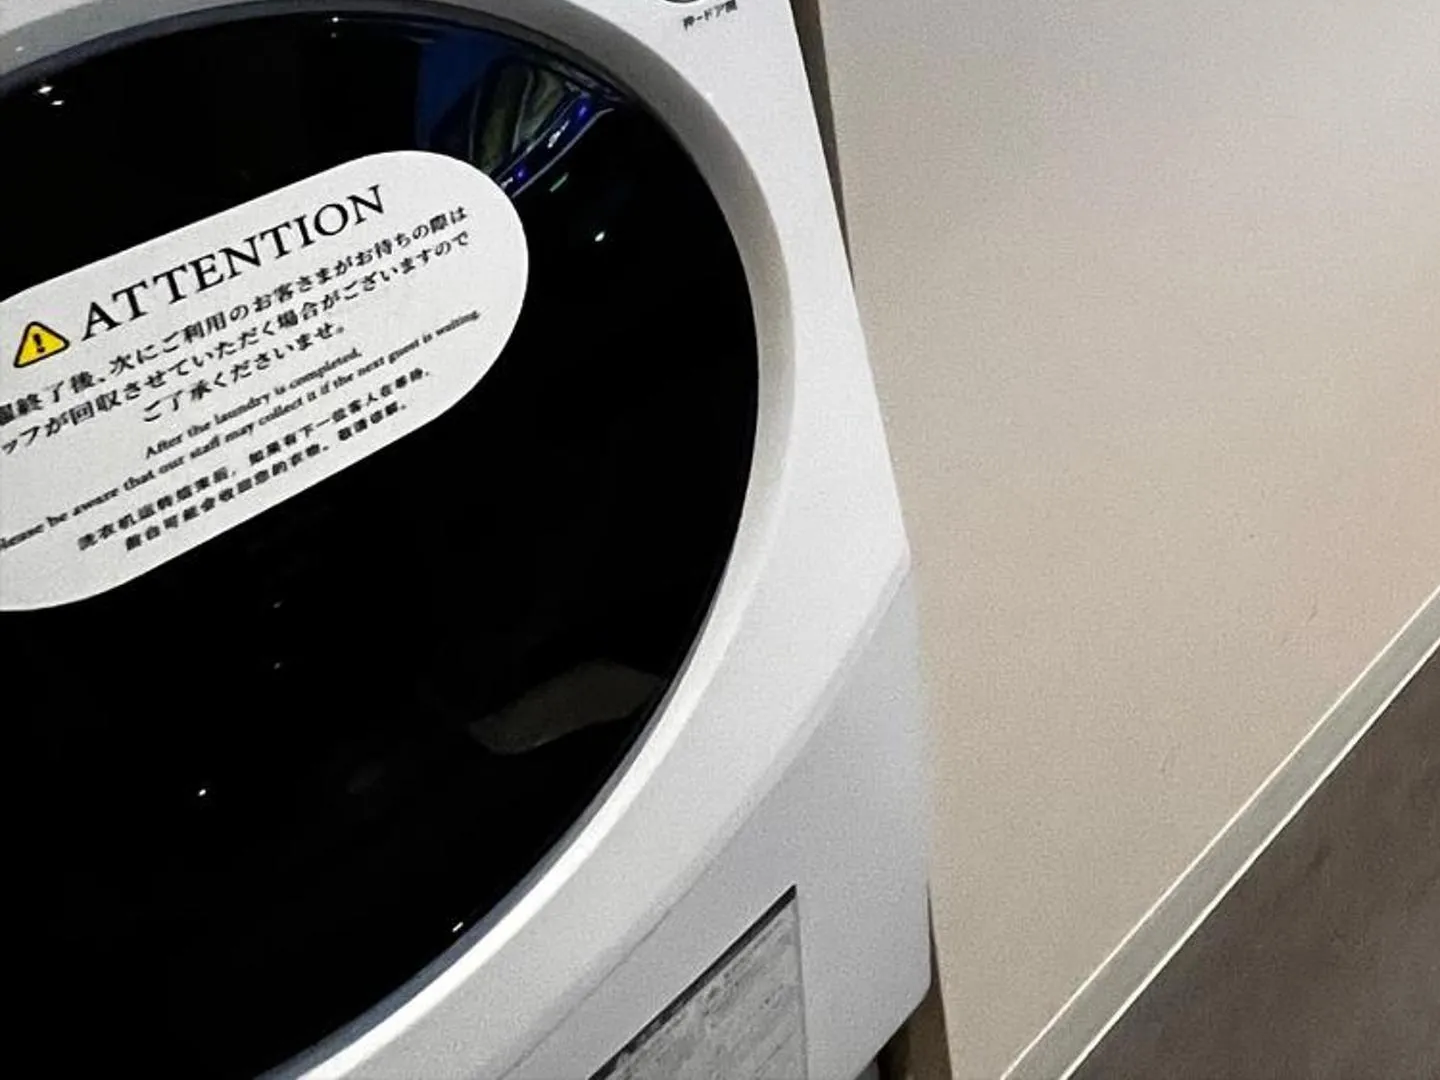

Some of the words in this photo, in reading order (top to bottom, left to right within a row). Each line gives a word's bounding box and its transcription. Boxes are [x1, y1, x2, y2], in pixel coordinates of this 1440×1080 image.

[81, 184, 386, 341] ATTENTION
[0, 523, 45, 549] lease
[46, 512, 68, 527] be
[72, 488, 119, 516] aware
[123, 470, 156, 491] that
[158, 456, 185, 474] our
[225, 422, 255, 443] may
[258, 396, 303, 426] collect
[333, 372, 354, 390] the
[357, 356, 385, 377] next
[146, 433, 183, 459] After
[187, 421, 211, 438] the
[214, 393, 270, 424] laundry
[274, 385, 287, 395] is
